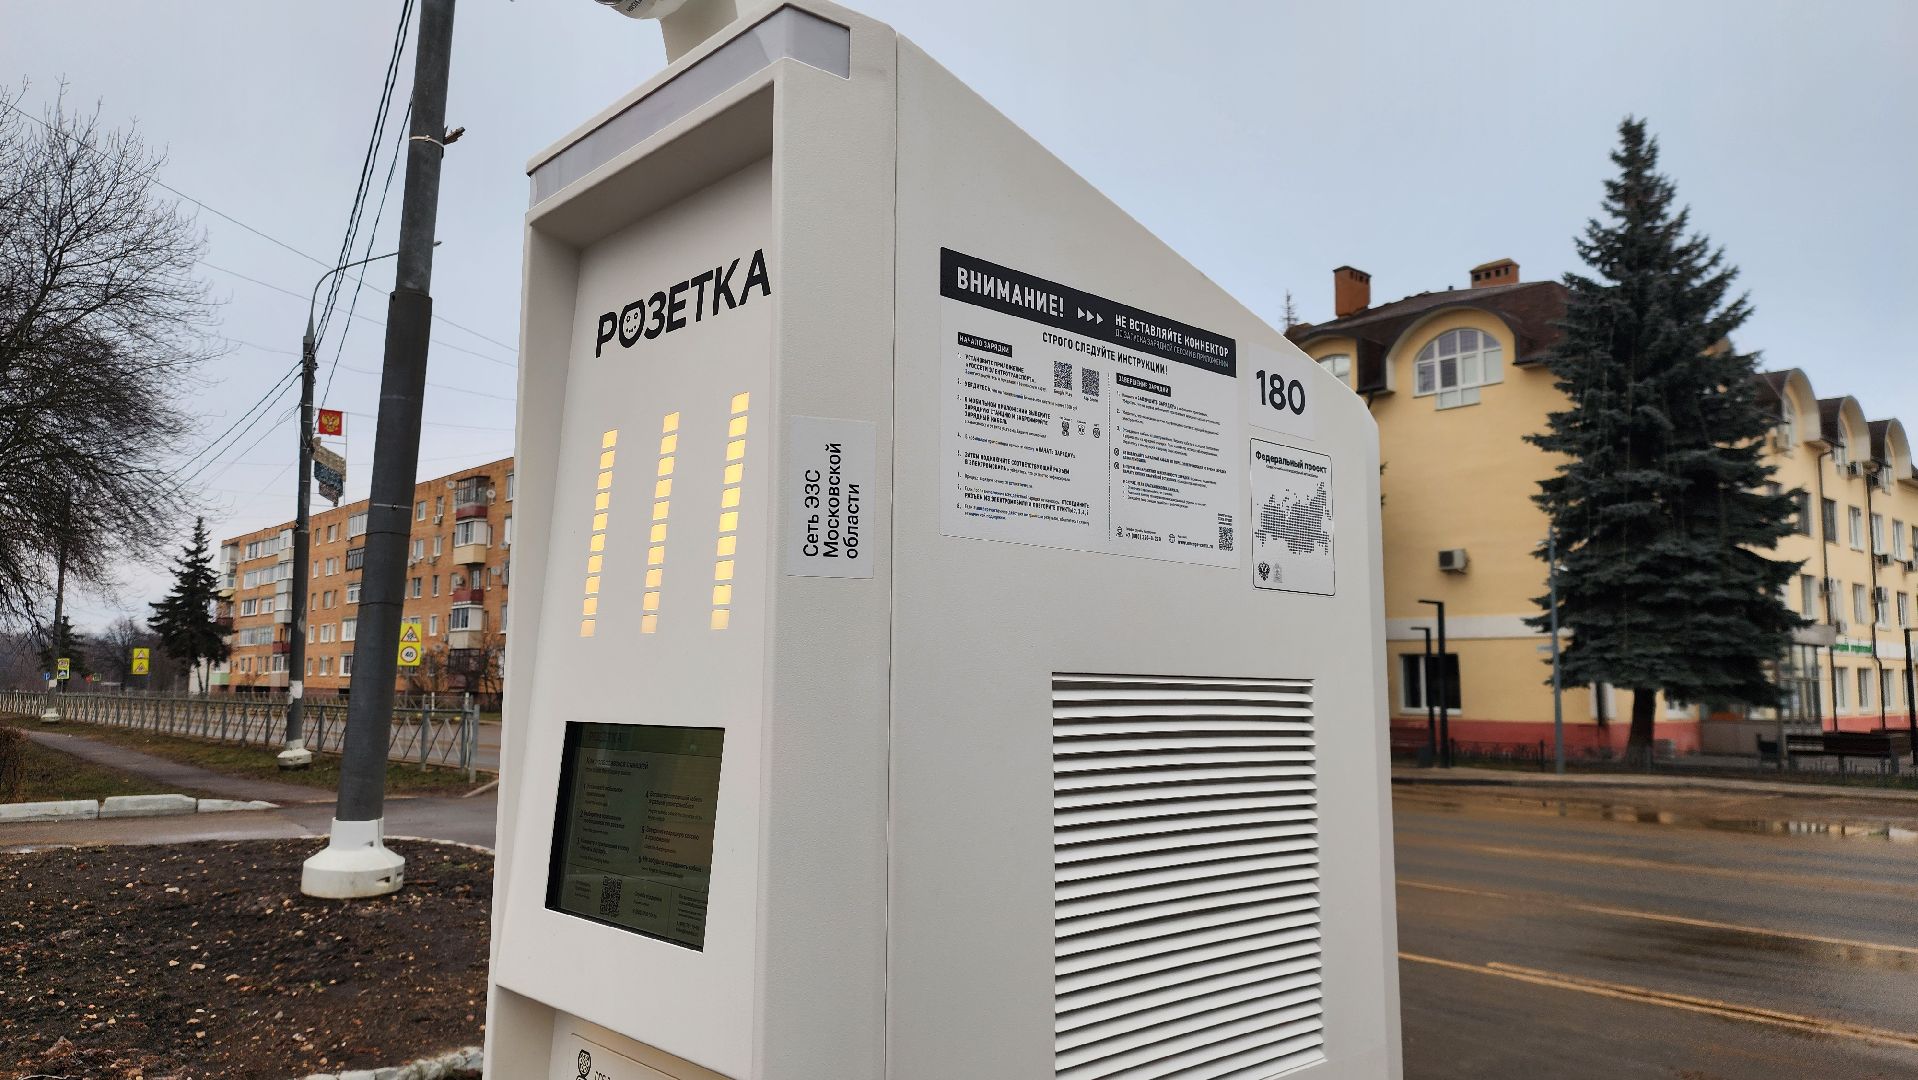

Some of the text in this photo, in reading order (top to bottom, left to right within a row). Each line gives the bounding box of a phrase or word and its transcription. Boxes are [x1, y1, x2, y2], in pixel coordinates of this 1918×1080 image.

[596, 248, 771, 358] РОЗЕТКА
[957, 266, 1064, 318] ВНИМАНИЕ!
[959, 335, 1009, 353] НАЧАЛО ЗАРЯДКИ
[1042, 332, 1168, 375] СТРОГО СЛЕДУЙТЕ ИНСТРУКЦИИ!
[1115, 314, 1229, 357] НЕ ВСТАВЛЯЙТЕ КОННЕКТОР
[1256, 369, 1305, 415] 180
[1255, 450, 1303, 469] Федеральный
[1304, 461, 1327, 474] проект
[802, 469, 820, 557] Сеть ЭЗС
[823, 443, 841, 557] Московской
[843, 484, 859, 559] области
